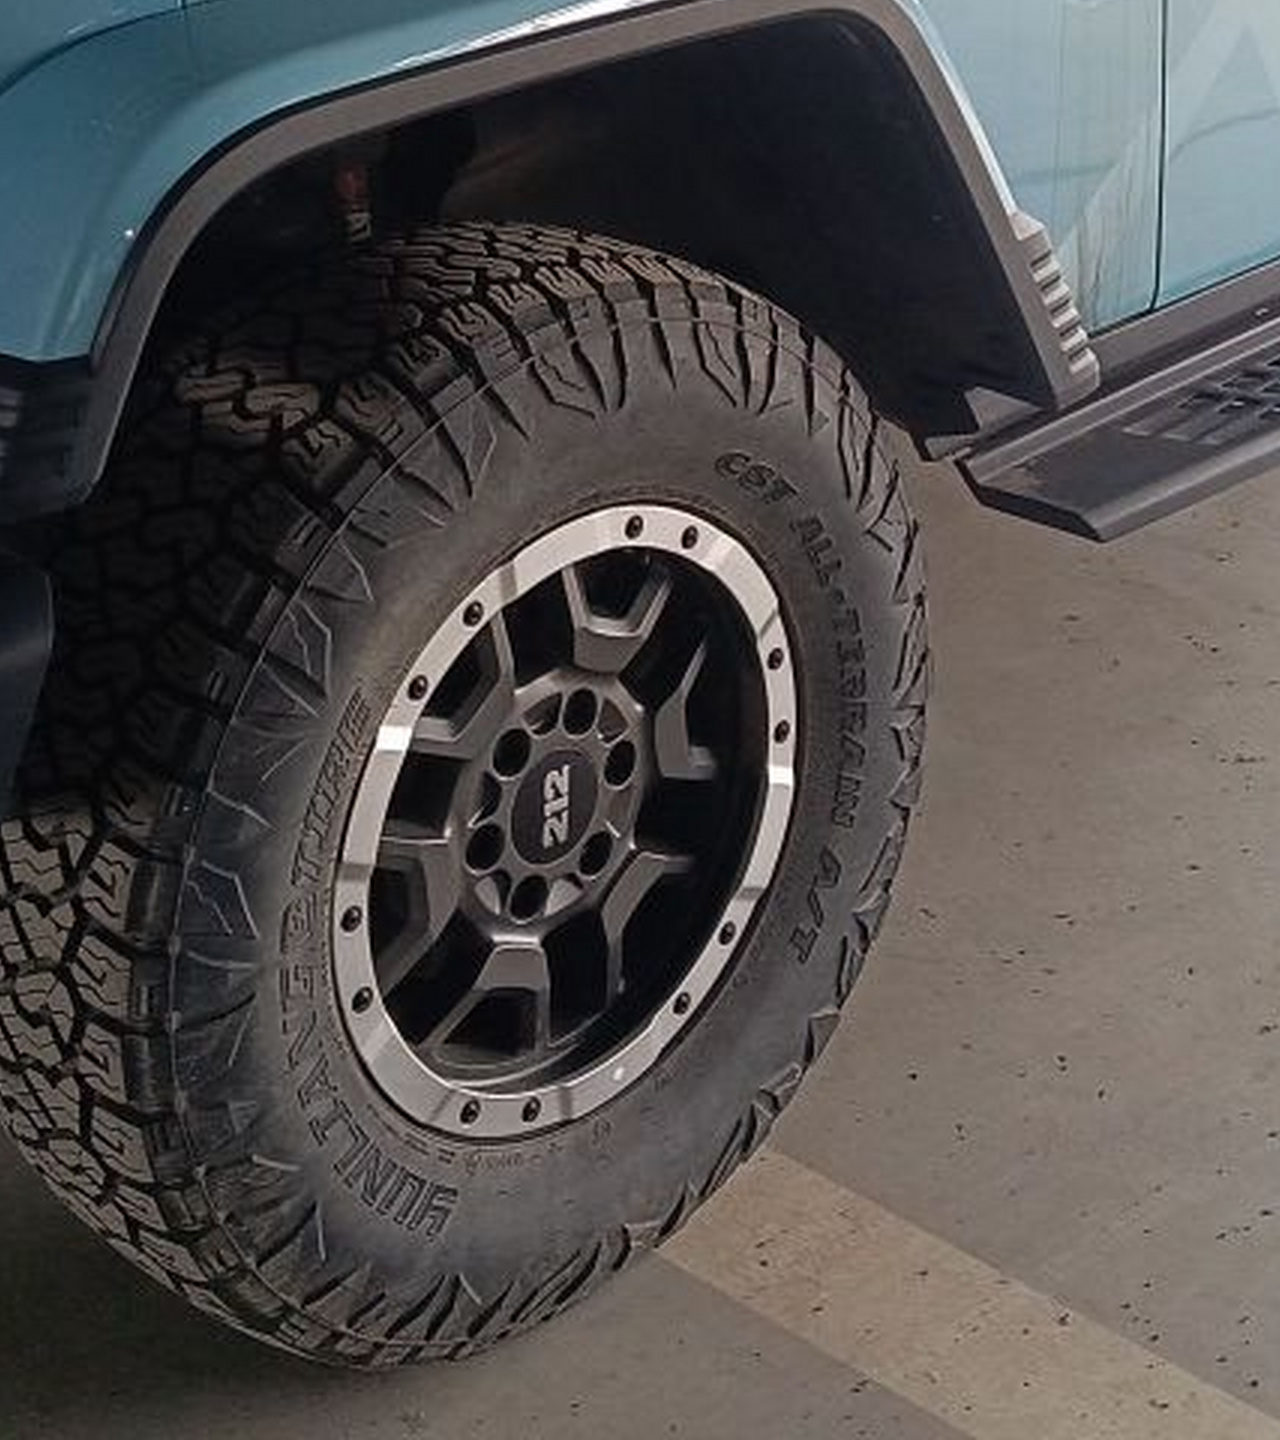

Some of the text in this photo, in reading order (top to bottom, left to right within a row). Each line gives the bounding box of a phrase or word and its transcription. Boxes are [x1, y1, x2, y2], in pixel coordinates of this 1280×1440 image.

[541, 763, 571, 849] 212
[713, 446, 797, 509] CST
[782, 844, 841, 968] A/T
